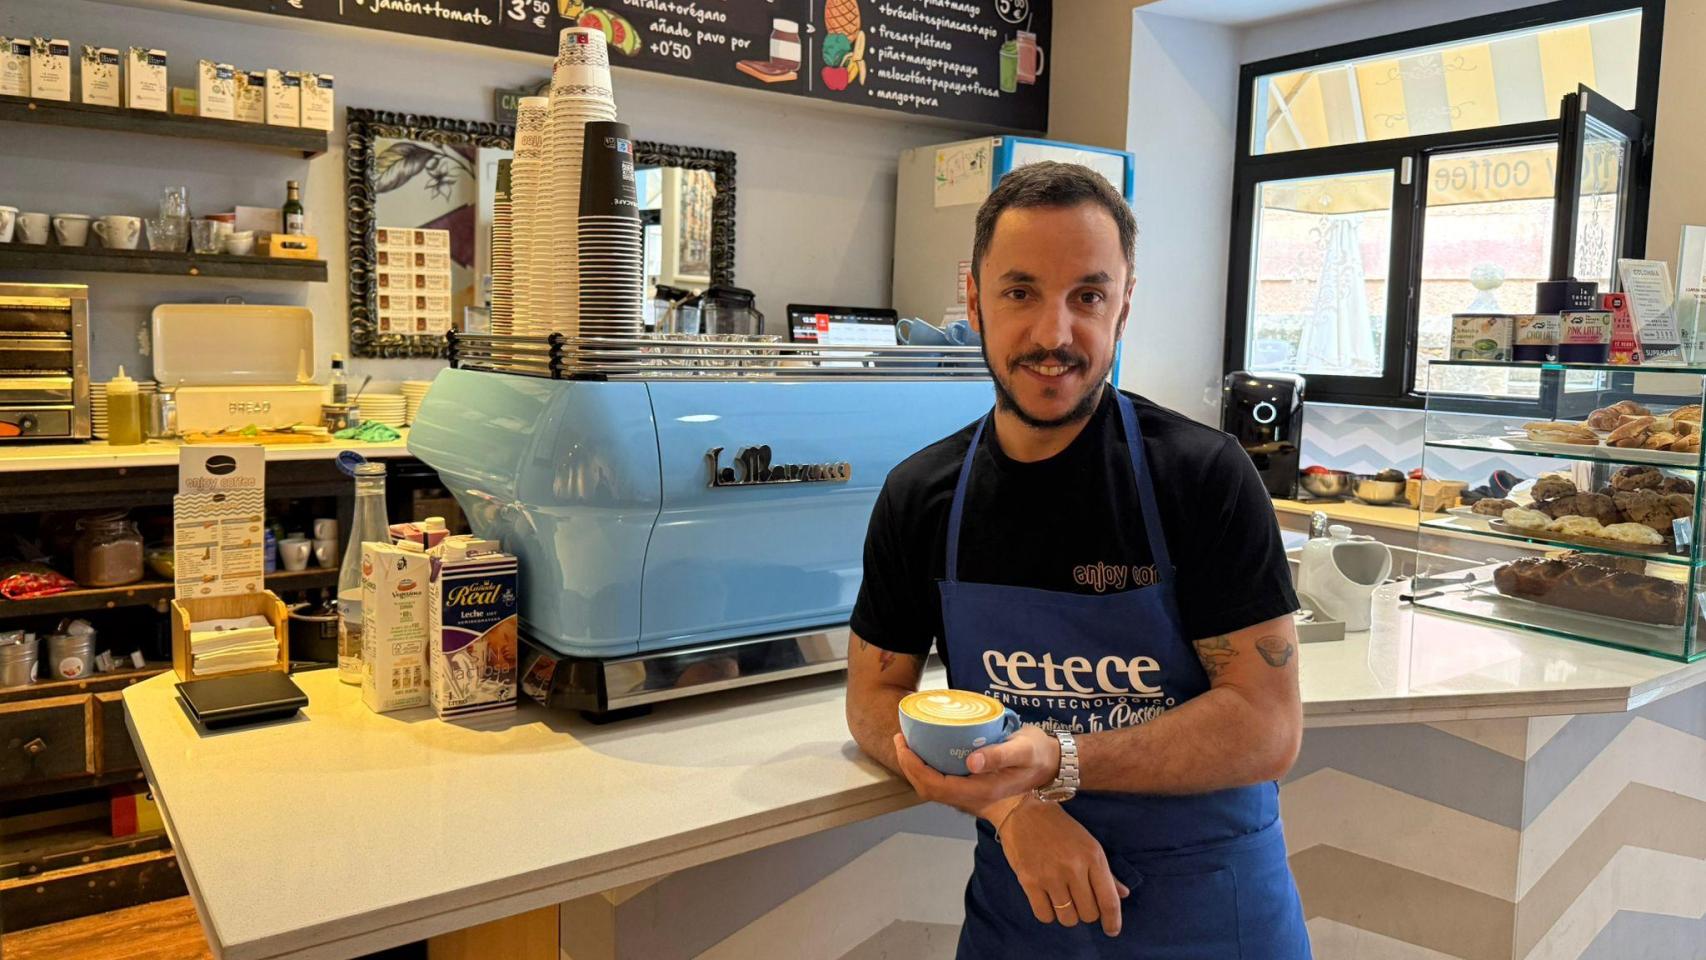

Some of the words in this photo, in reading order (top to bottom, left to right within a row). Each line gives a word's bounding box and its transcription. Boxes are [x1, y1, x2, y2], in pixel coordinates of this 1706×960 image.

[649, 18, 692, 38] añade
[696, 30, 726, 45] pavo
[731, 37, 752, 51] por
[878, 46, 979, 78] piña+mango+papaya
[877, 66, 1000, 98] melocotón+papaya+fresa
[876, 89, 939, 108] mango+pera
[229, 401, 271, 414] BREAD
[1073, 561, 1128, 592] enjoy
[446, 584, 503, 607] Real
[460, 609, 484, 619] Leche
[984, 690, 1041, 708] CENTRO
